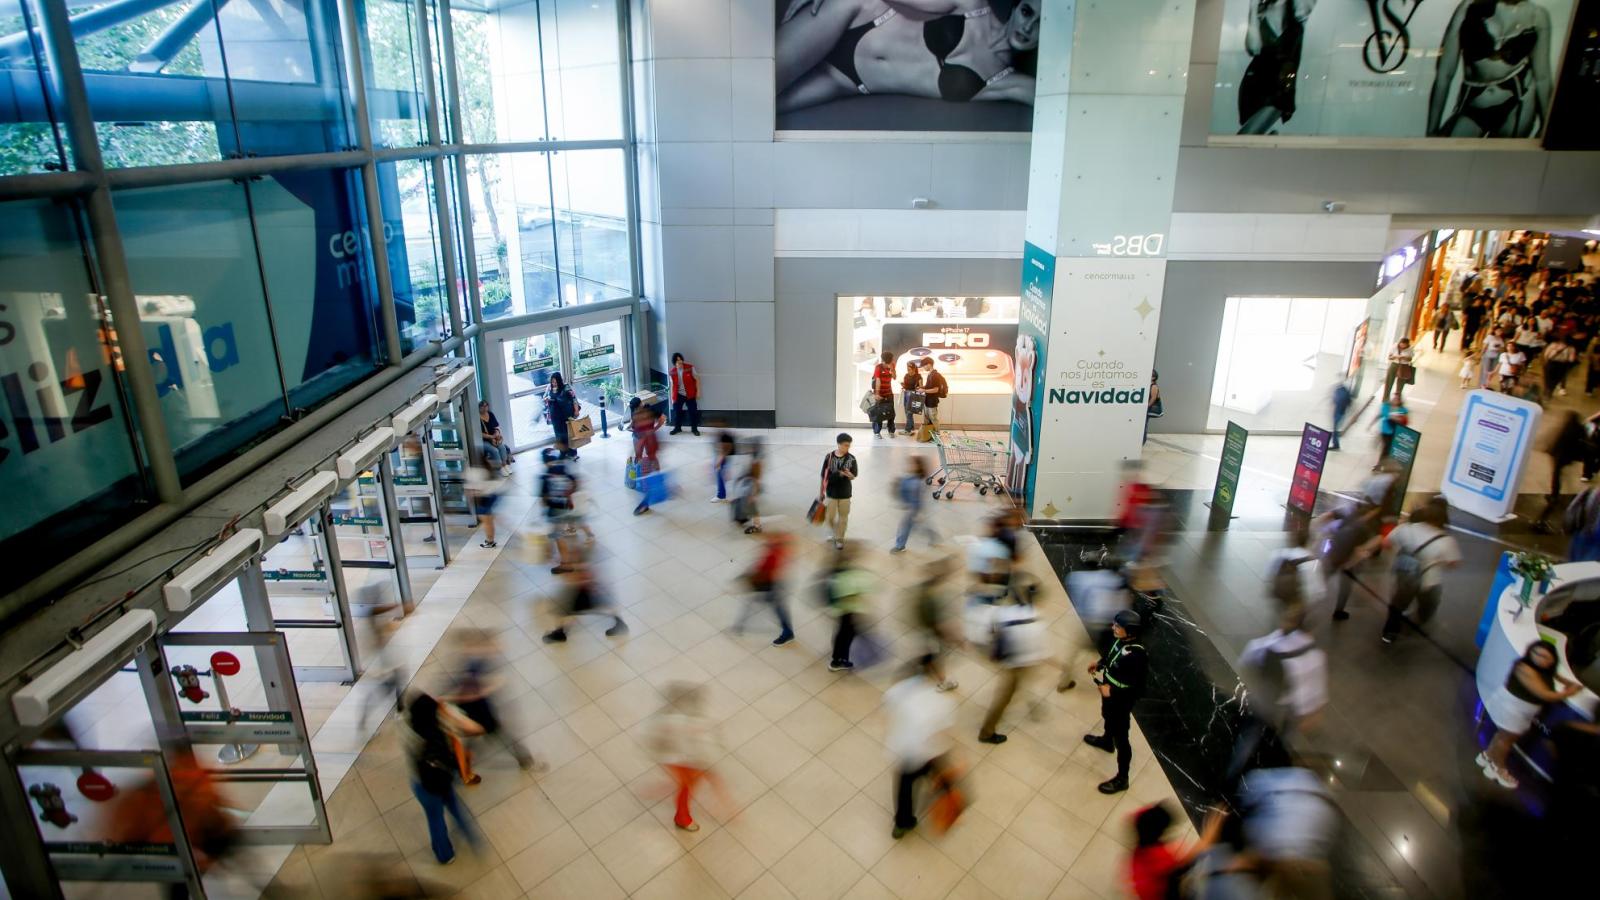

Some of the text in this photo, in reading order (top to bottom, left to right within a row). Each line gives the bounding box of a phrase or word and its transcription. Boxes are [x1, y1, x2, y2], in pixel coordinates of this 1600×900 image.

[923, 333, 990, 347] PRO
[1076, 359, 1124, 370] Cuando
[1060, 369, 1138, 381] nos juntamos
[1092, 381, 1105, 389] es
[1049, 387, 1145, 404] Navidad
[248, 712, 286, 721] Navidad
